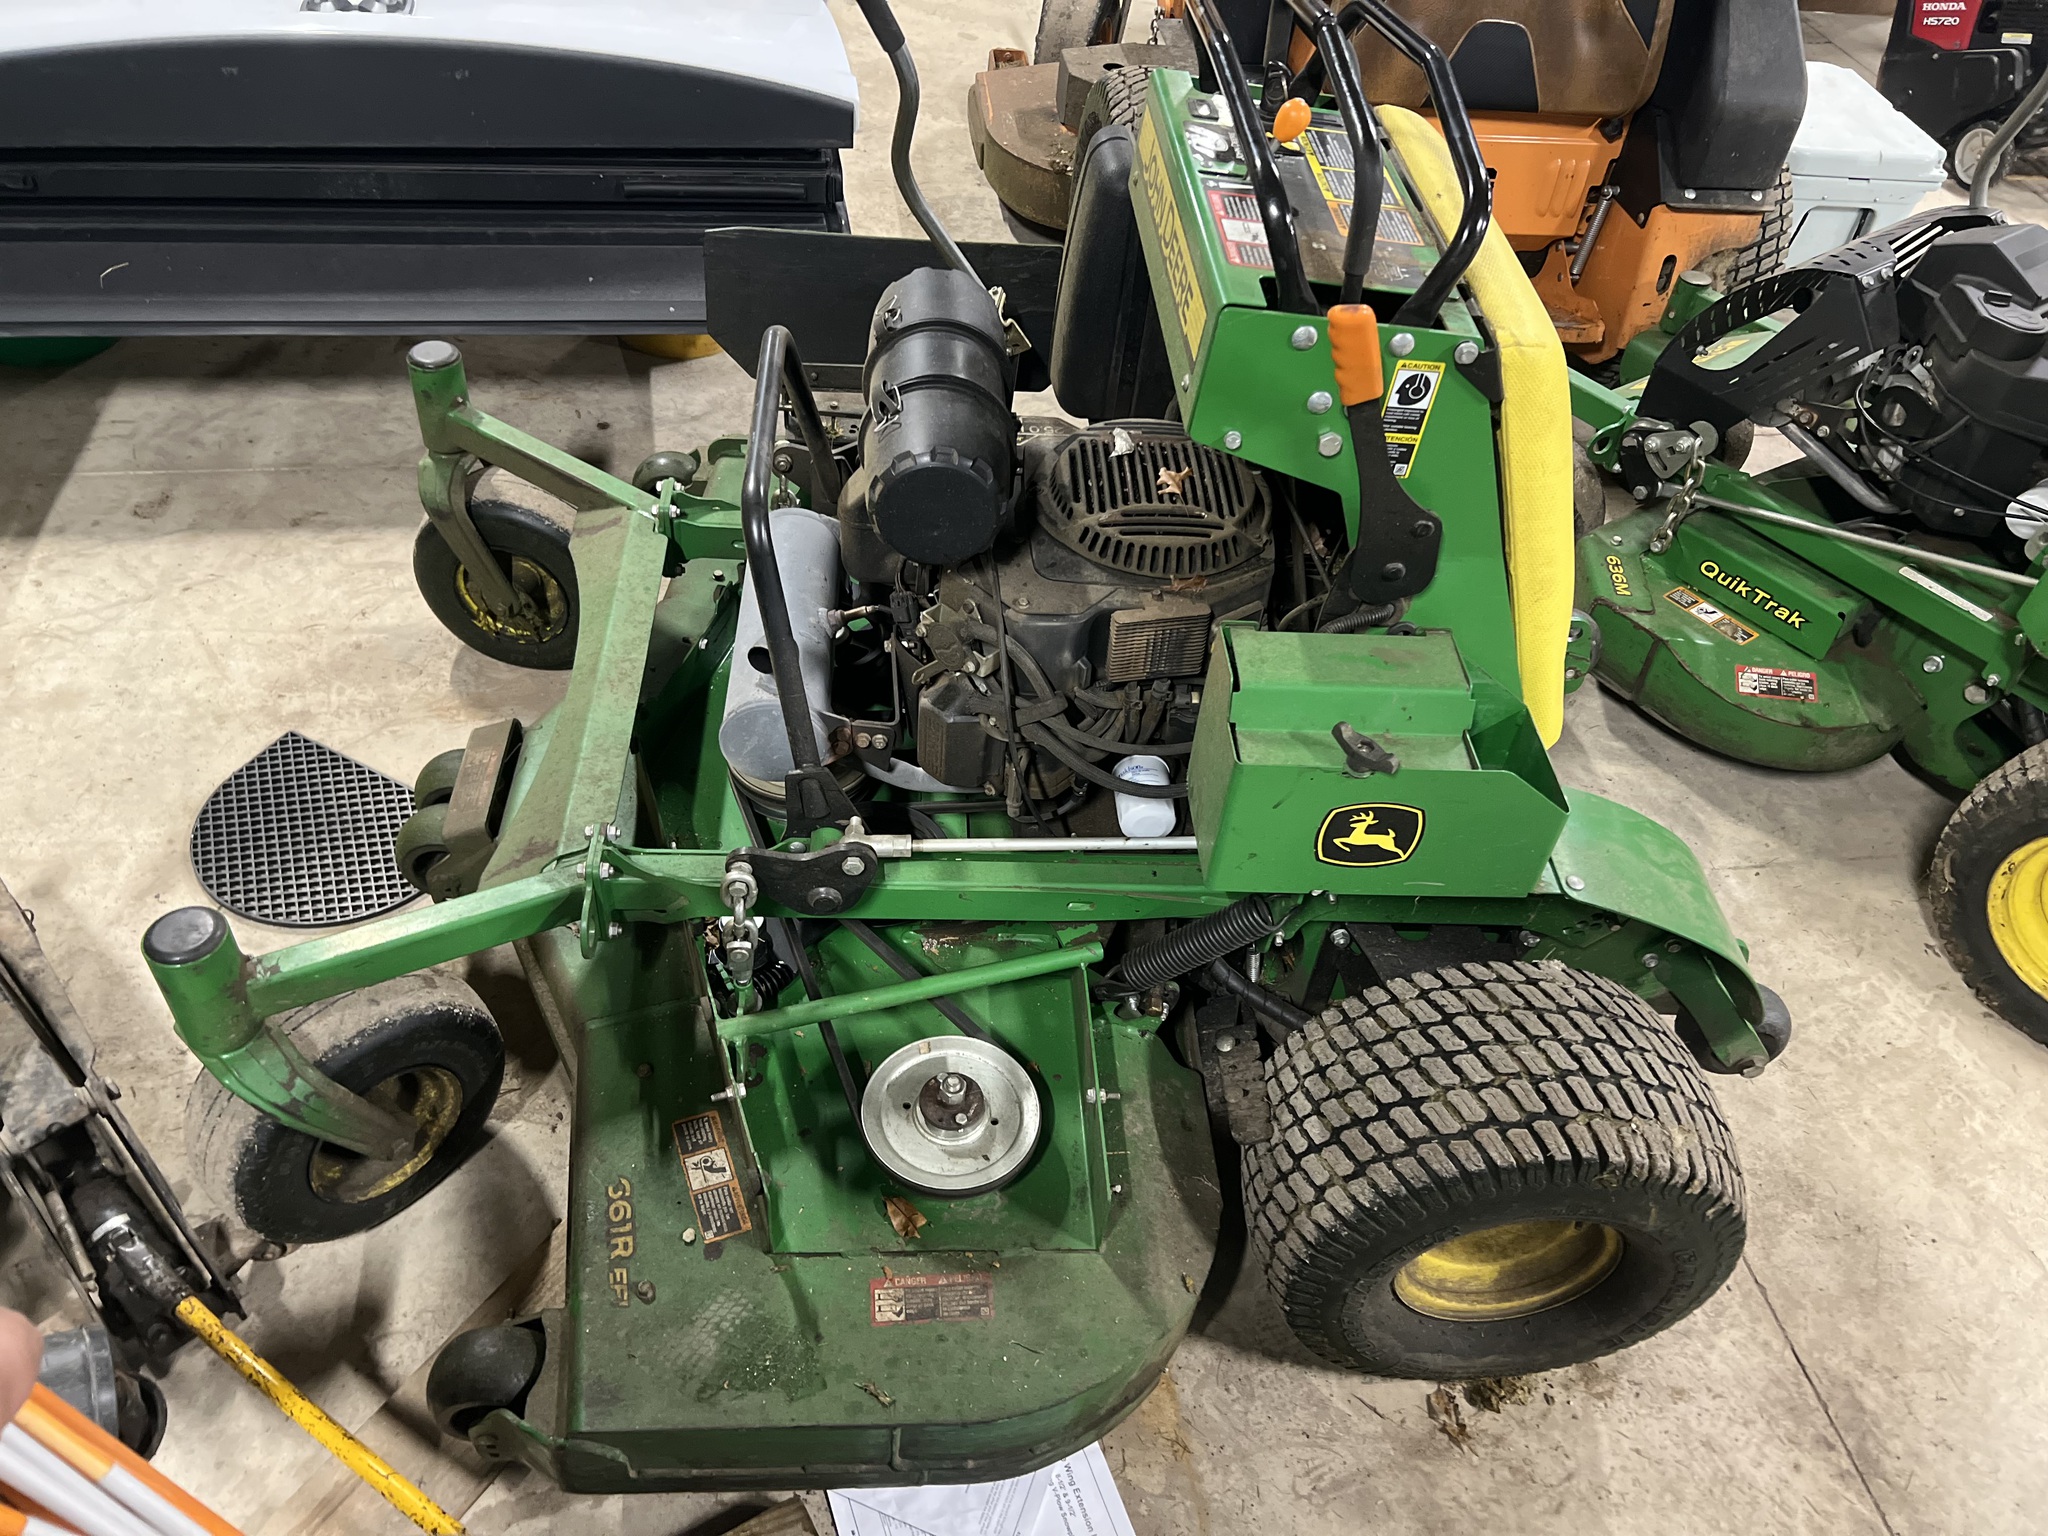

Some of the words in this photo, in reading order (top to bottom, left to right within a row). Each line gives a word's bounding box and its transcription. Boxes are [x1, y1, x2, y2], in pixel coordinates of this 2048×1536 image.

[1922, 2, 1966, 11] HONDA
[1923, 16, 1960, 26] HS720
[1144, 138, 1168, 230] JOHN
[1162, 201, 1194, 325] DEERE
[1407, 362, 1441, 371] CAUTION
[1386, 433, 1418, 443] TENCIÓN
[1606, 555, 1632, 596] 636M
[1699, 560, 1807, 631] QuikTrak
[1064, 1462, 1076, 1487] Wing
[1073, 1487, 1095, 1533] Extension
